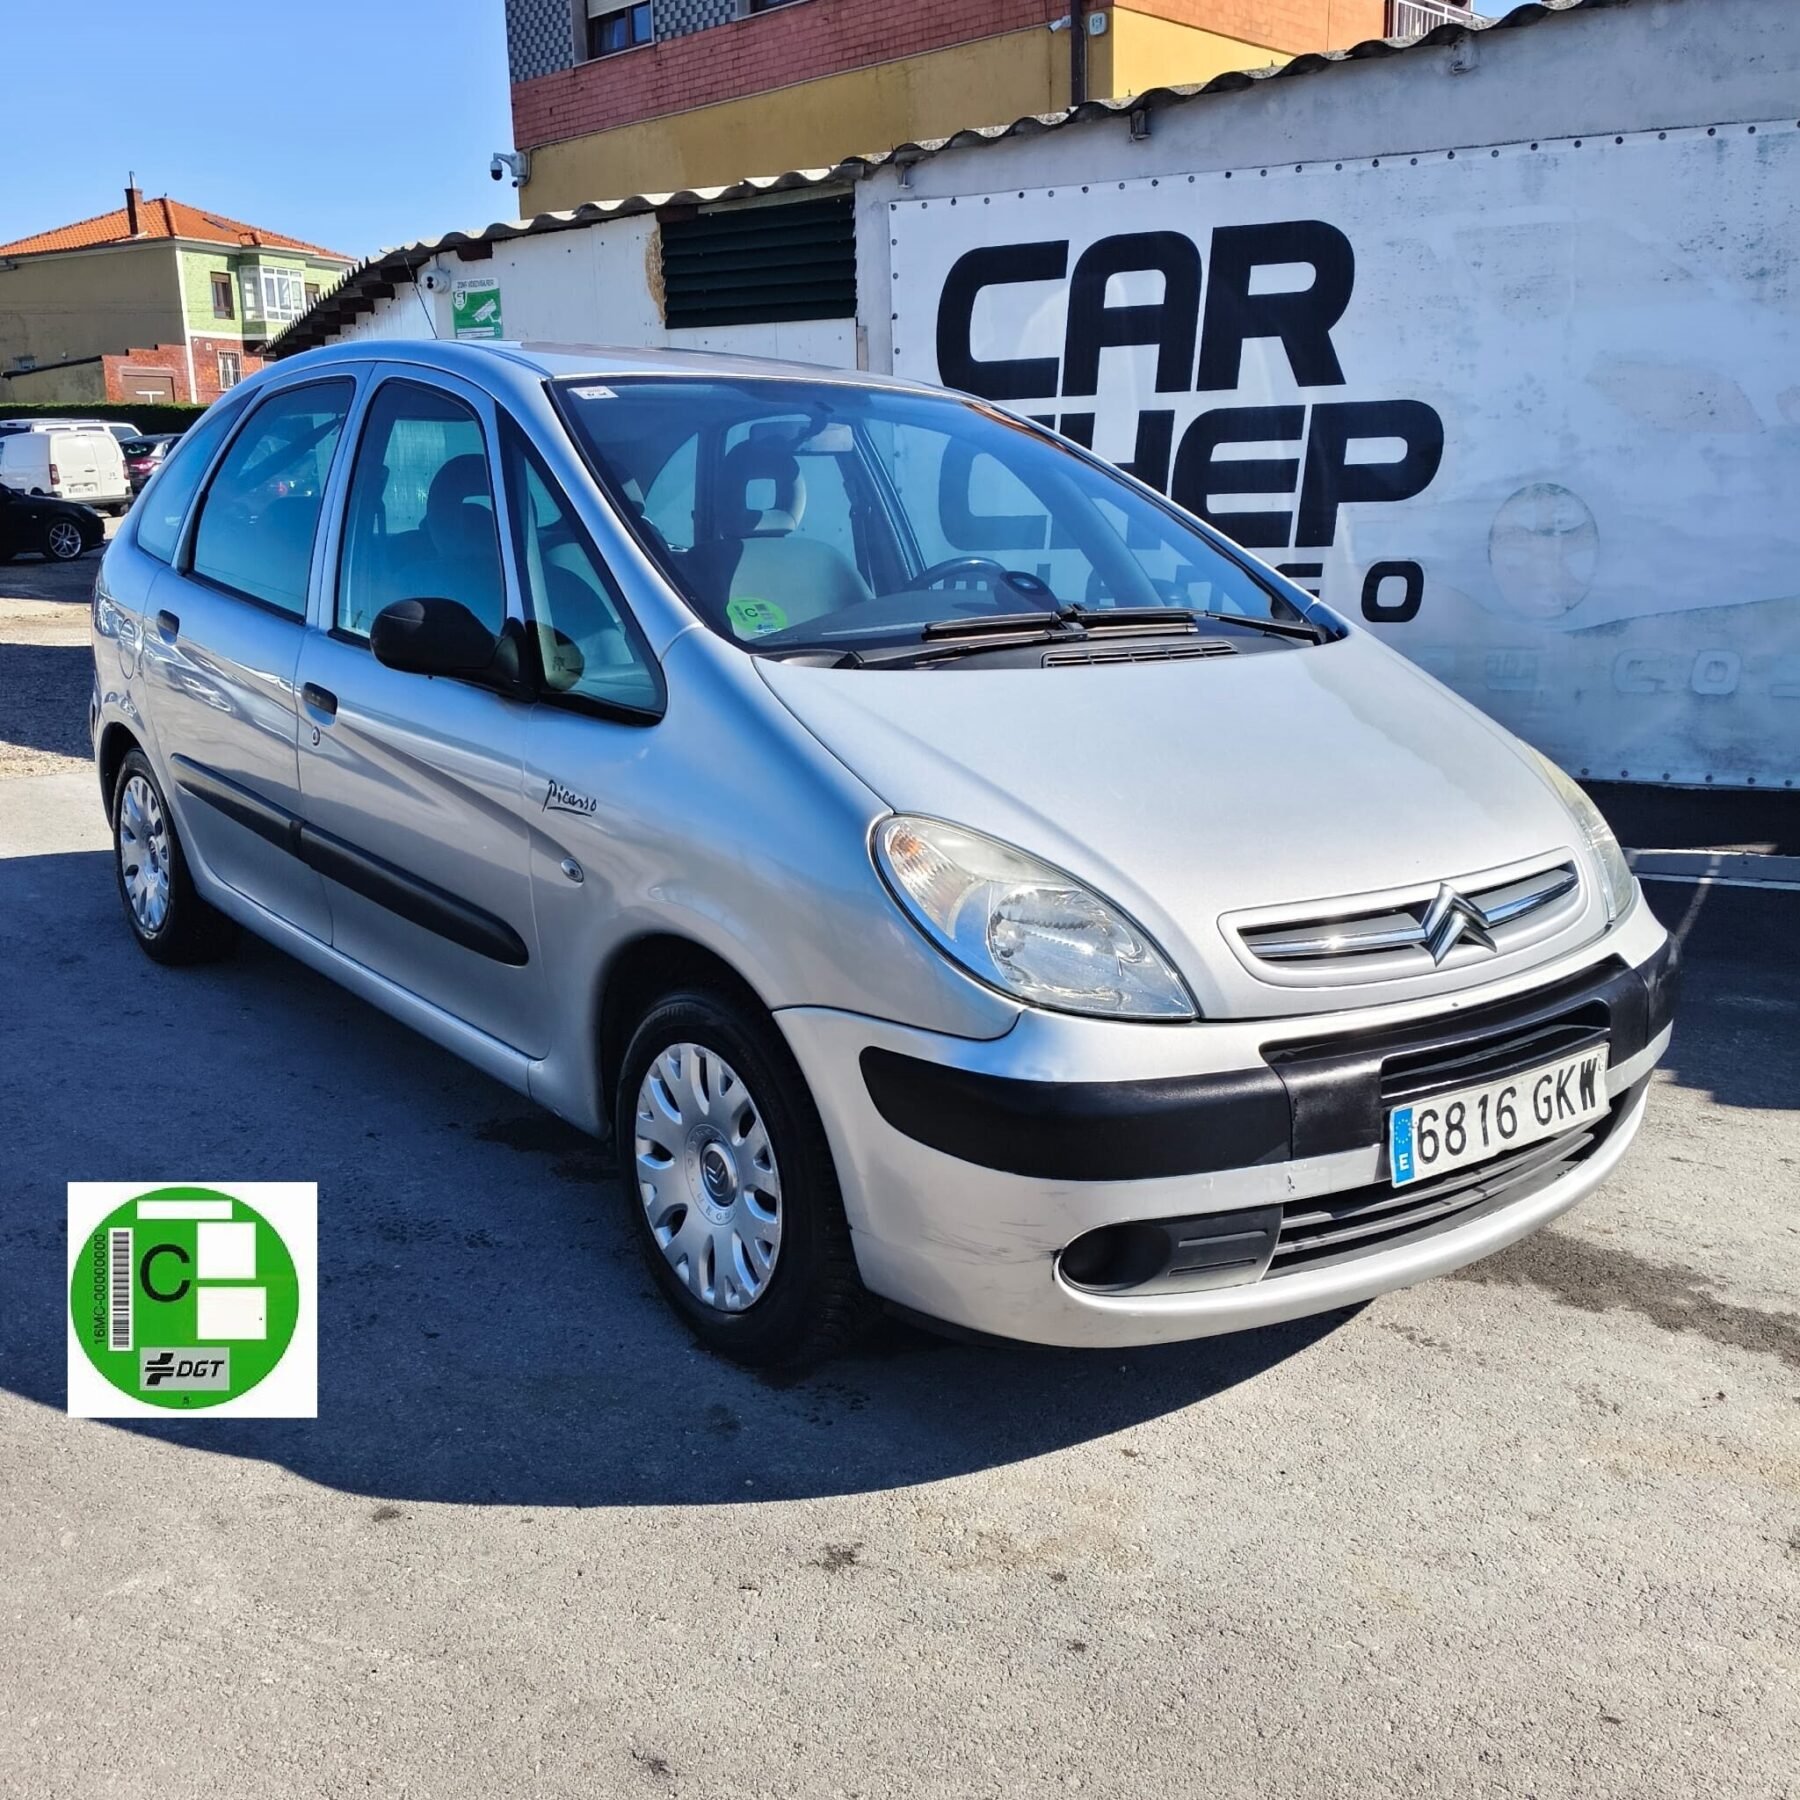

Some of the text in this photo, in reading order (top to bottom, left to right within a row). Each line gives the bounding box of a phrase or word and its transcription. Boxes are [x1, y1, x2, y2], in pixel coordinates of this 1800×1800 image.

[936, 219, 1355, 401] CAR
[542, 779, 597, 816] Picasso
[1417, 1057, 1598, 1164] 6816 GKW
[1399, 1154, 1409, 1171] E
